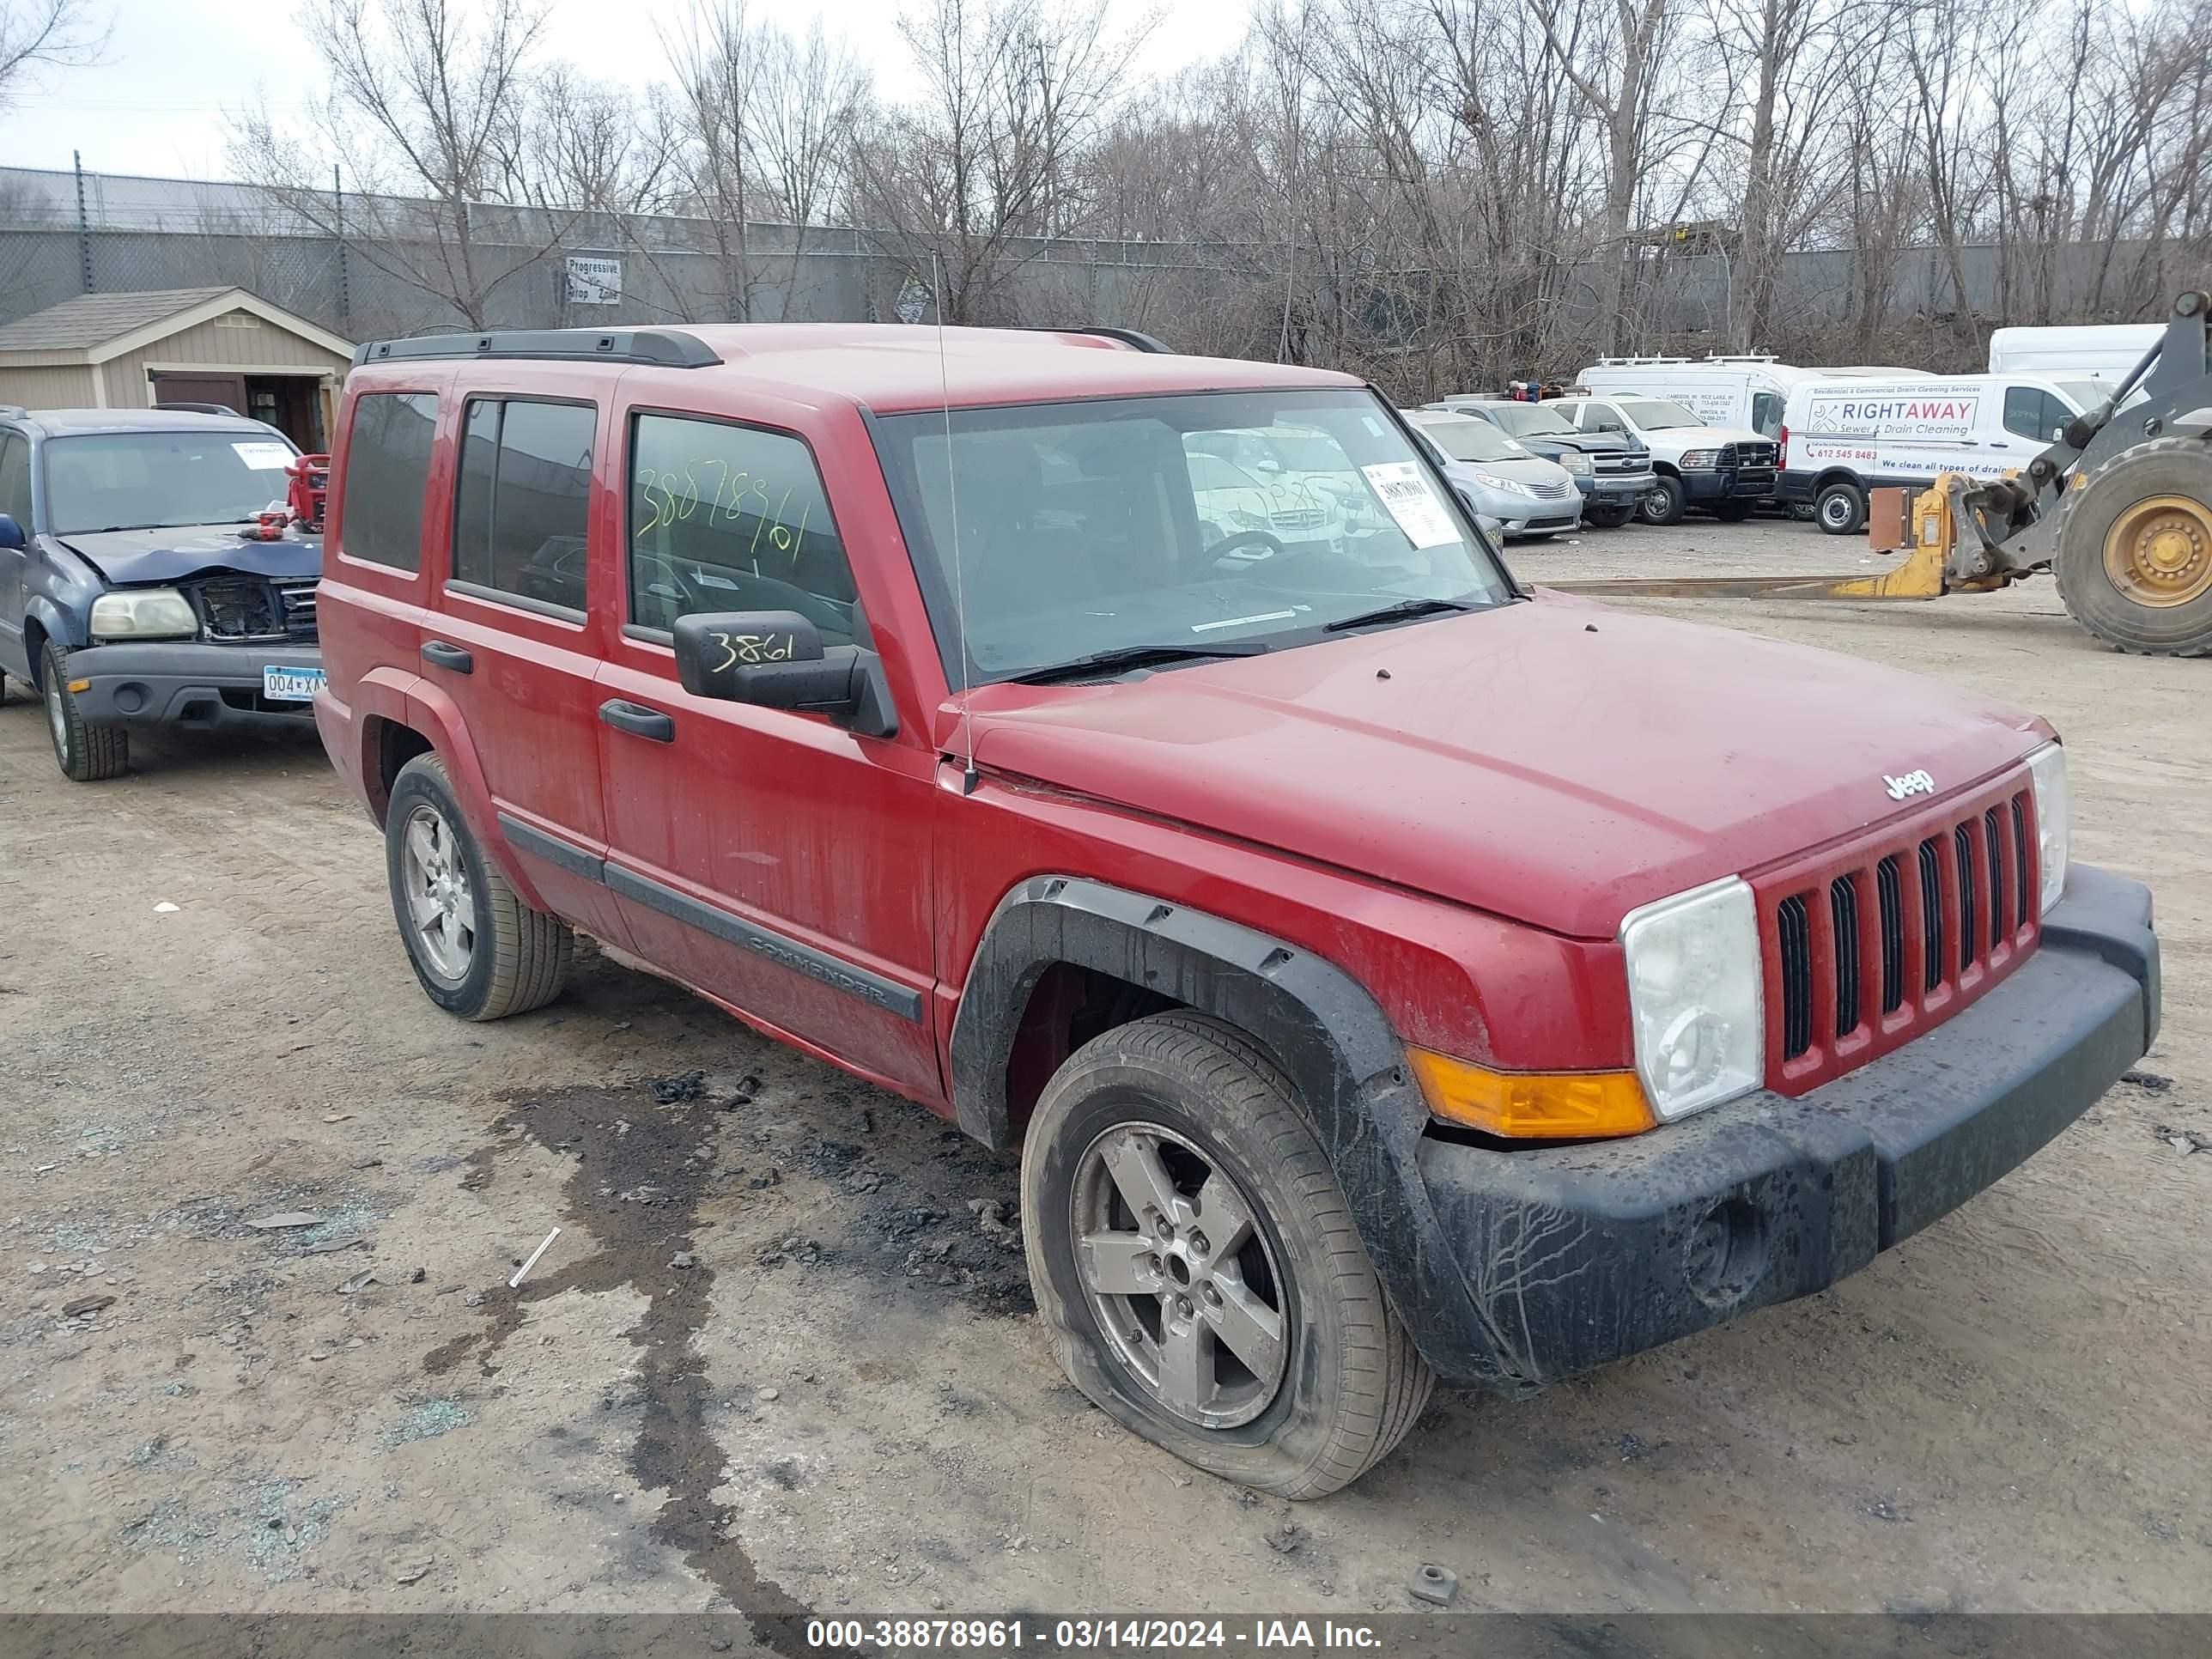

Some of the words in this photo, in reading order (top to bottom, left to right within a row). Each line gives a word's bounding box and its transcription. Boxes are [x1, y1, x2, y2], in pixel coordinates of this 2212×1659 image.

[570, 259, 617, 274] Progressive
[1842, 402, 1972, 420] RIGHTAWAY
[1840, 424, 1870, 433] Sewer
[1884, 424, 1912, 434] Drain
[1916, 423, 1968, 436] Cleaning
[1818, 449, 1833, 458] 612
[1836, 449, 1852, 459] 545
[1855, 450, 1877, 459] 8483
[1899, 460, 1922, 469] clean
[1940, 464, 1966, 472] types
[1969, 464, 1979, 472] of
[1380, 481, 1427, 499] 38878961
[636, 459, 811, 564] 38878961
[709, 632, 793, 673] 3861
[269, 675, 295, 692] 004
[1881, 769, 1935, 800] Jeep
